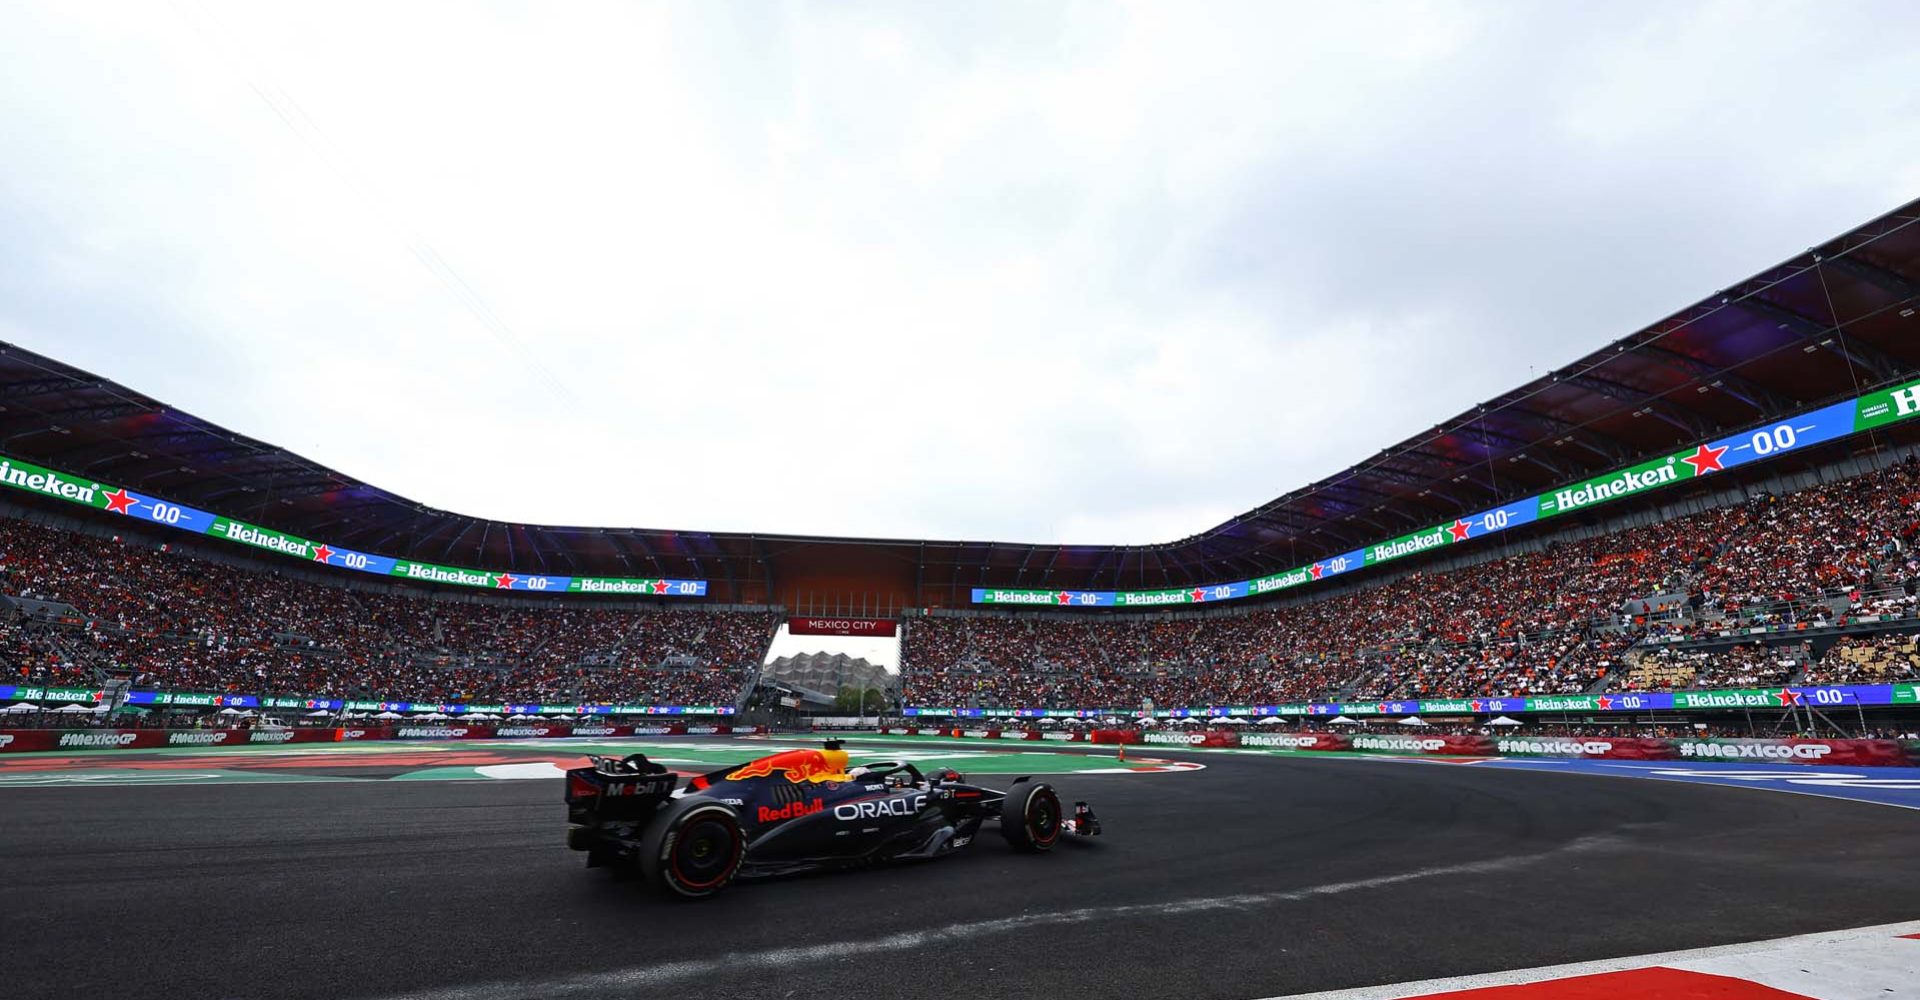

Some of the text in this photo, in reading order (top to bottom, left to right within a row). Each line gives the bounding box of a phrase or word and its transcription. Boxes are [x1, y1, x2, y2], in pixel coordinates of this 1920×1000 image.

[1555, 424, 1796, 511] Heineken 0.0
[152, 503, 180, 525] 0.0
[1374, 509, 1508, 562] Heineken 0.0
[226, 522, 367, 569] Heineken 0.0
[408, 563, 546, 590] Heineken 0.0
[1257, 568, 1308, 593] Heineken
[581, 579, 697, 594] Heineken 0.0
[994, 591, 1051, 604] Heineken
[1126, 590, 1185, 605] Heineken
[808, 620, 877, 630] MEXICO CITY
[1535, 696, 1641, 710] Heineken 0.0
[1686, 689, 1843, 707] Heineken 0.0
[1425, 701, 1467, 712] Heineken
[59, 733, 137, 747] #MexicoGP
[169, 732, 227, 744] #MexicoGP
[250, 731, 294, 742] #MexicoGP
[398, 728, 468, 737] #MexicoGP
[1144, 733, 1206, 744] #MexicoGP
[1240, 736, 1318, 747] #MexicoGP
[1352, 738, 1446, 751] #MexicoGP
[1498, 740, 1613, 755] #MexicoGP
[1680, 742, 1832, 759] #MexicoGP
[607, 781, 657, 797] Mobil
[758, 797, 824, 823] Red Bull
[834, 795, 927, 821] ORACLE
